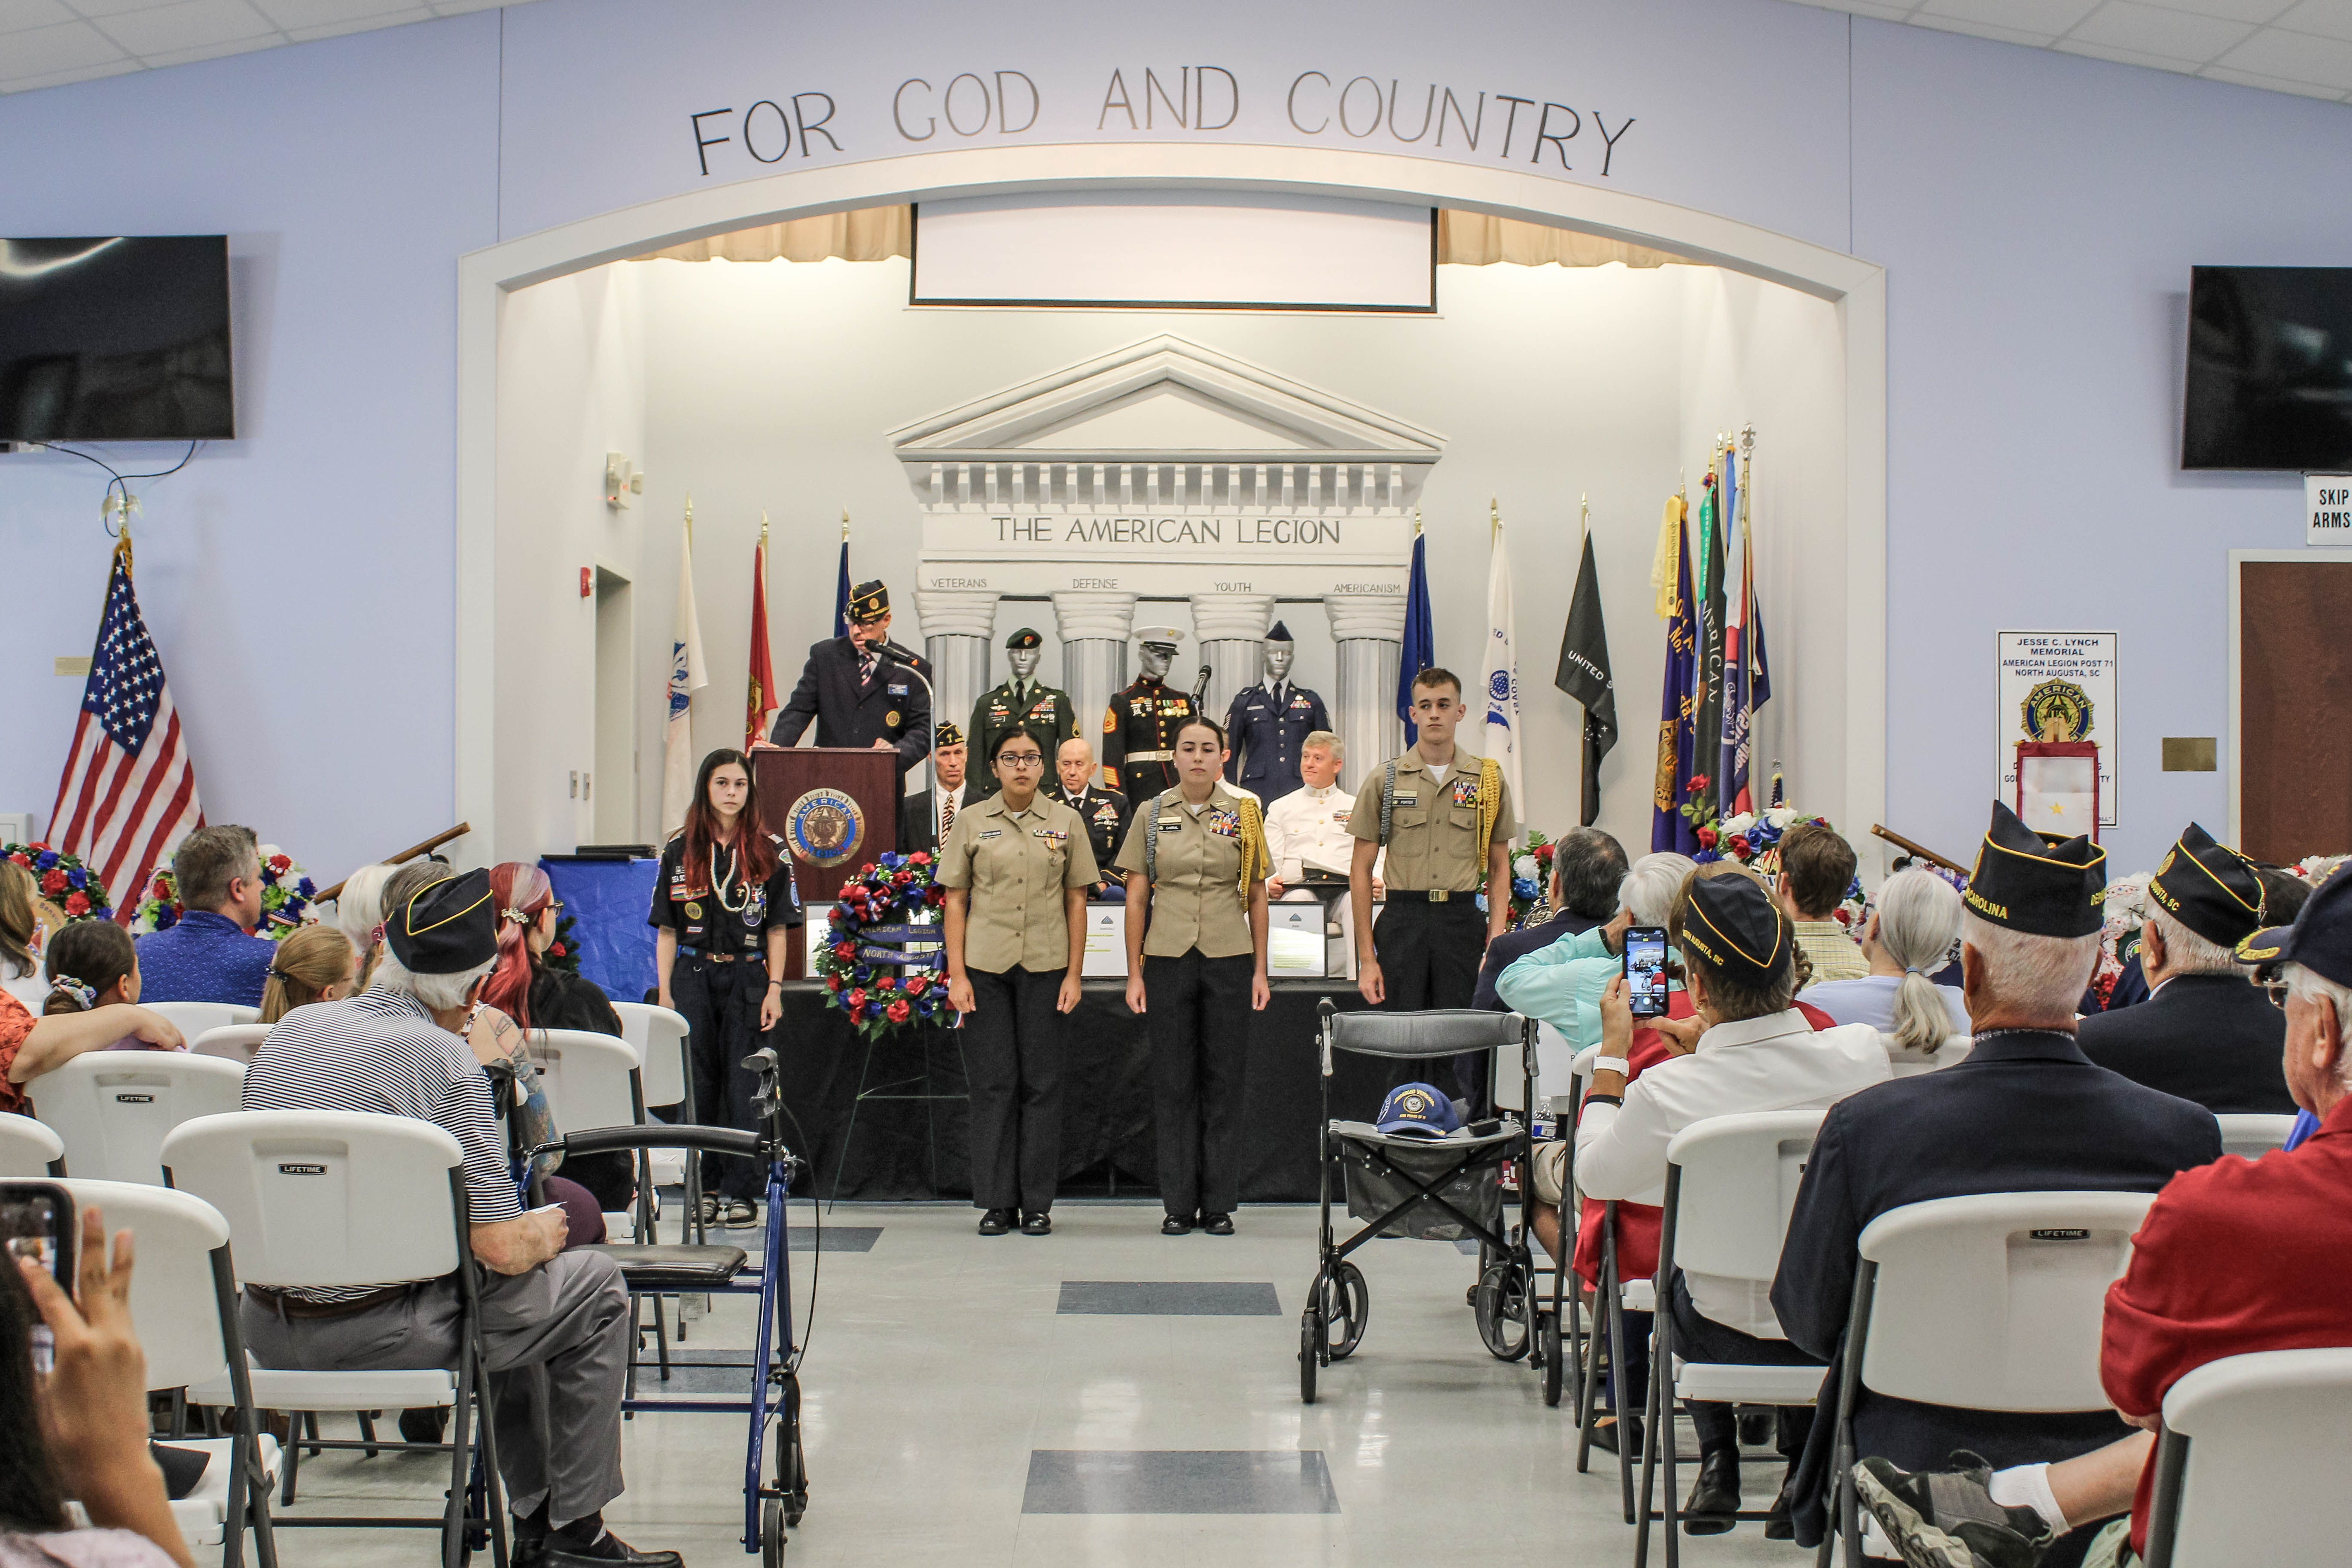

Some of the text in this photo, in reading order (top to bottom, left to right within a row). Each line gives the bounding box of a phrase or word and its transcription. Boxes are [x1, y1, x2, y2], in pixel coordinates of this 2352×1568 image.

[691, 65, 1636, 177] FOR GOD AND COUNTRY
[2319, 489, 2349, 505] SKIP
[991, 517, 1341, 545] THE AMERICAN LEGION
[930, 578, 987, 588] VETERANS
[1072, 578, 1118, 589] DEFENSE
[1214, 582, 1252, 592] YOUTH
[1333, 583, 1401, 594] AMERICANISM
[1568, 649, 1604, 680] UNITED
[2046, 669, 2087, 678] AUGUSTA,
[2030, 685, 2087, 709] AMERICAN
[799, 798, 853, 820] AMERICAN
[1967, 889, 2008, 919] CAROLINA
[2167, 898, 2179, 911] SC
[862, 948, 894, 958] NORTH
